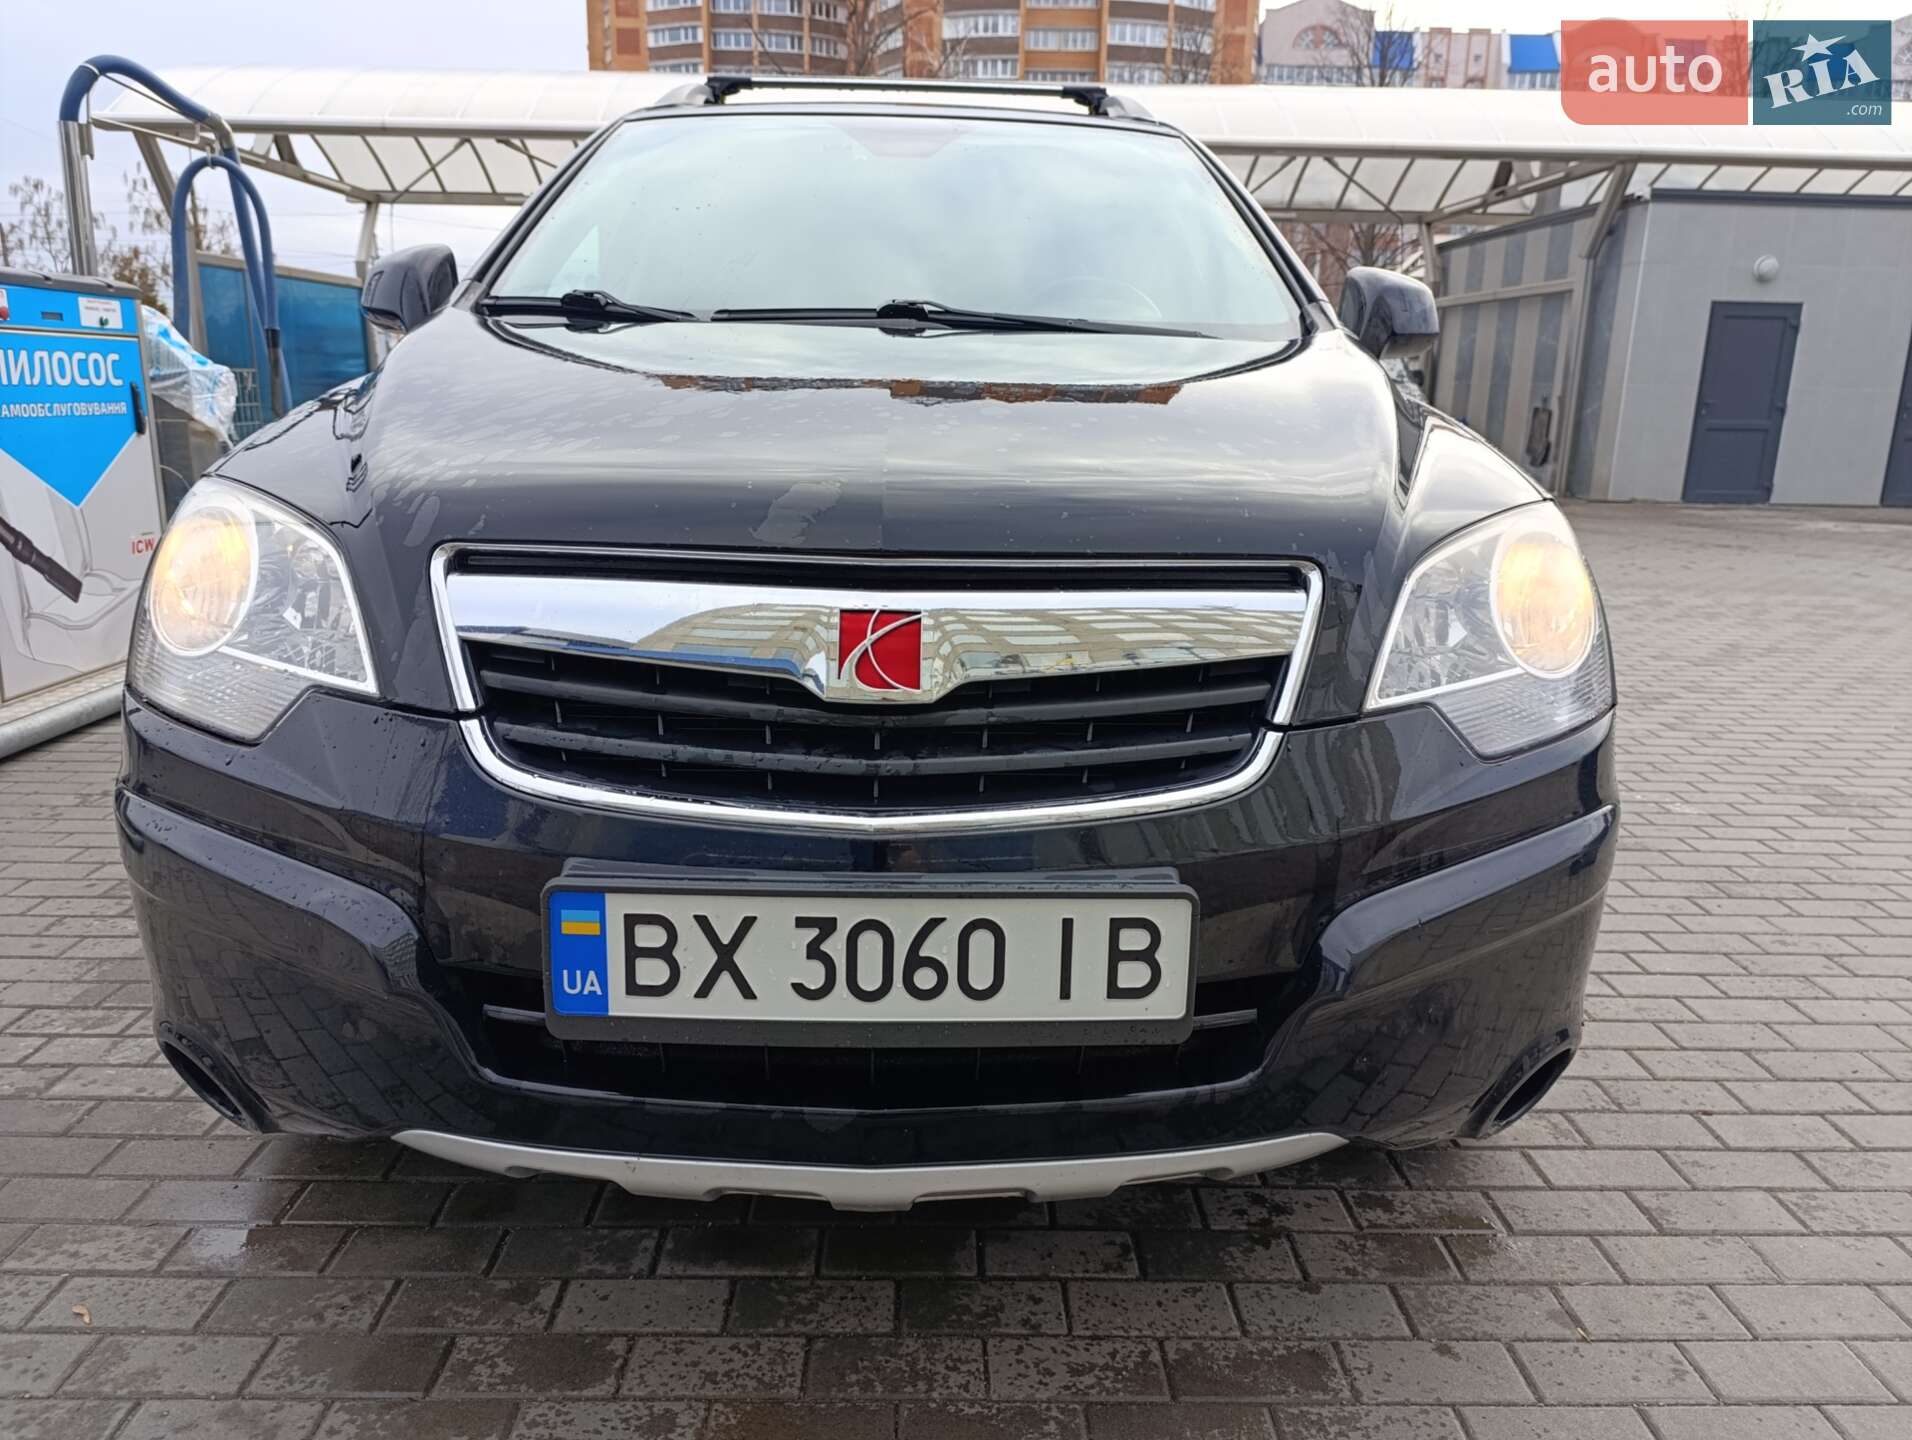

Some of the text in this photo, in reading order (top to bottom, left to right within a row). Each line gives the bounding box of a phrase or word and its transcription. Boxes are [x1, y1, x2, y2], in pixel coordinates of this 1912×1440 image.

[563, 970, 602, 997] UA
[623, 912, 1162, 1003] BX 3060 IB
